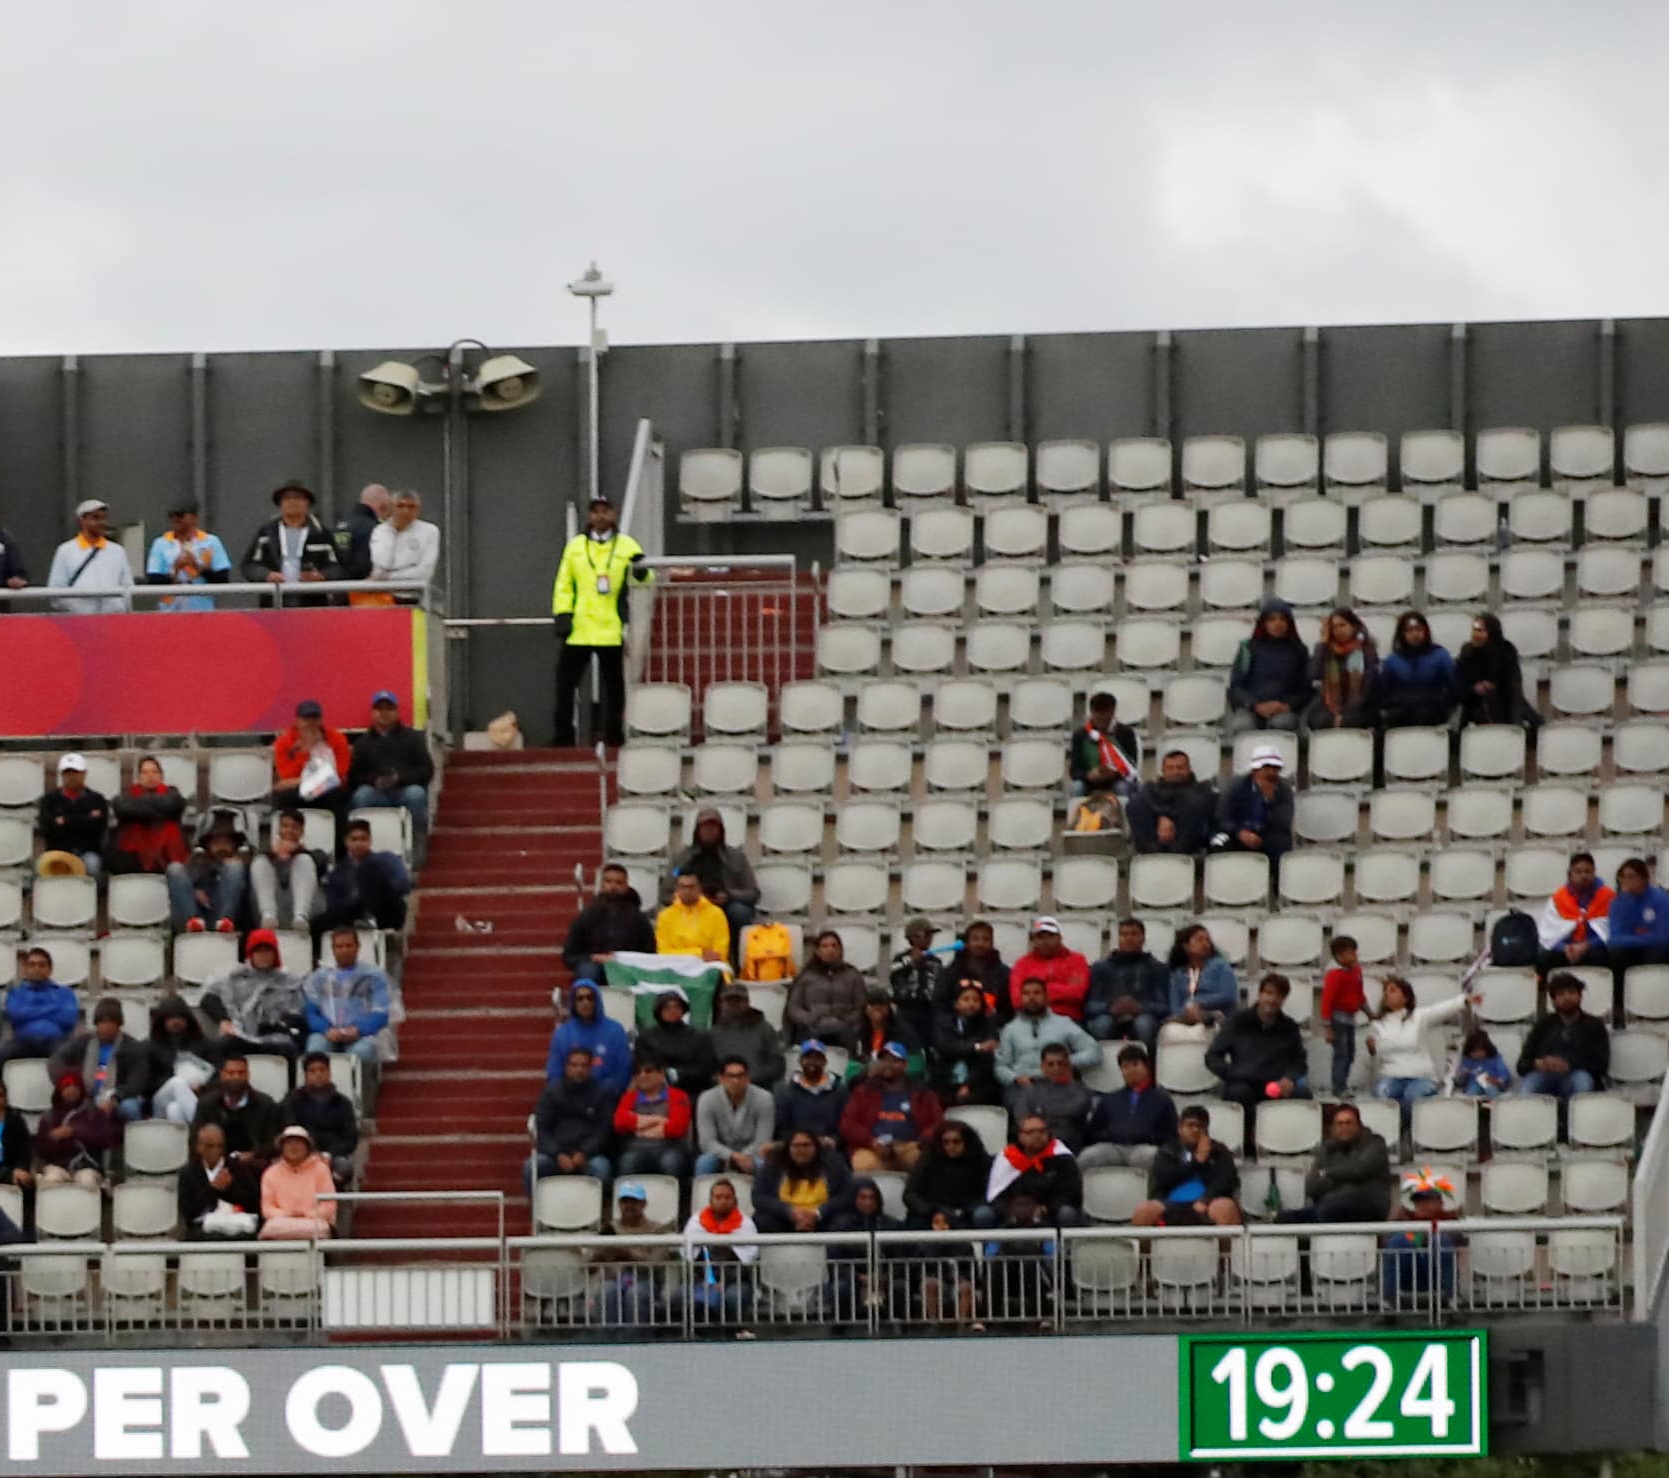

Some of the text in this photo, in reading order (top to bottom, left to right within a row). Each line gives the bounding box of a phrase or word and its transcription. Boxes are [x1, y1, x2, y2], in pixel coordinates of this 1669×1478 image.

[6, 1366, 252, 1461] PER
[284, 1361, 640, 1458] OVER
[1210, 1343, 1456, 1442] 19:24
